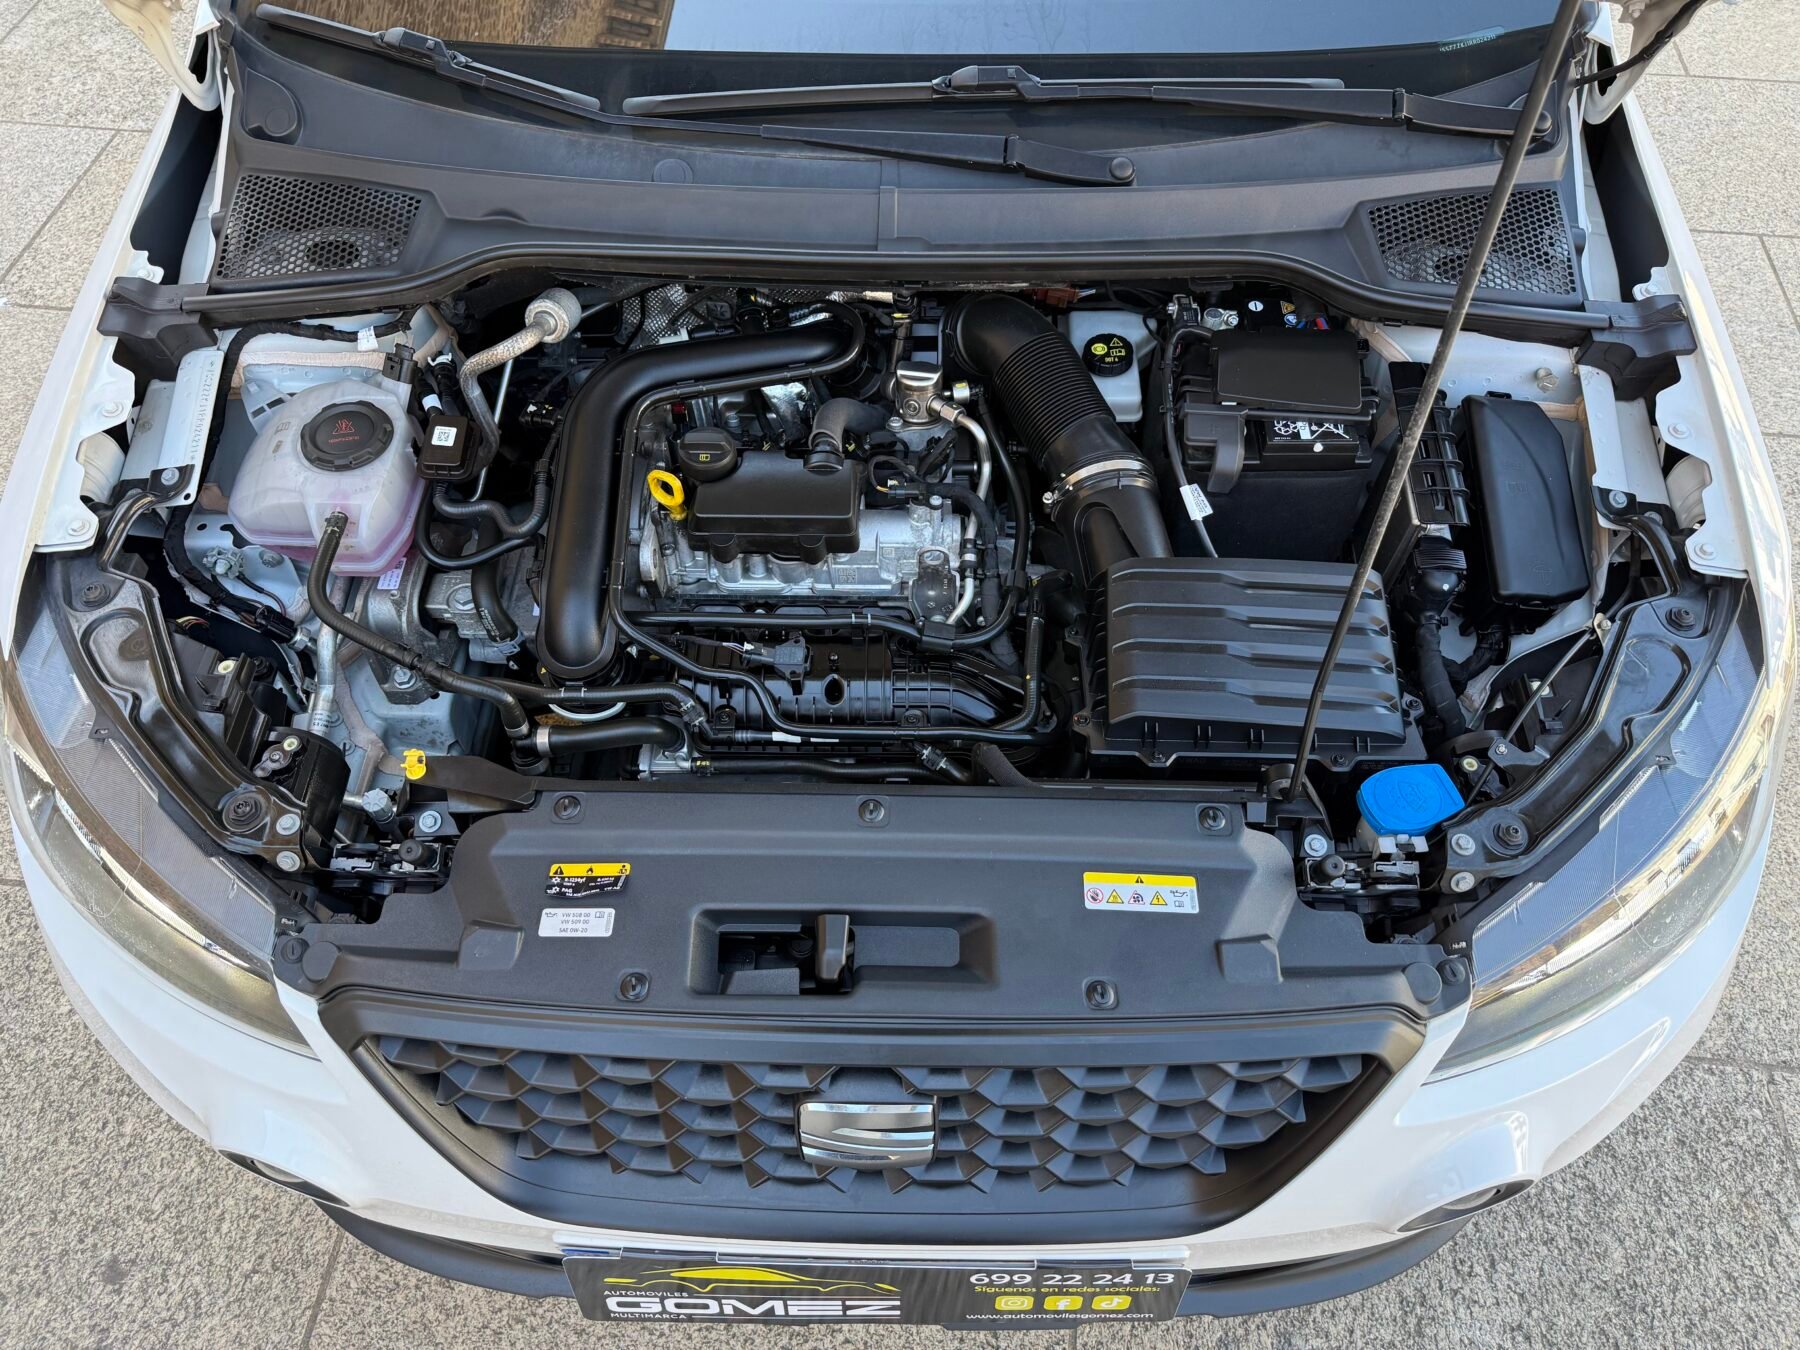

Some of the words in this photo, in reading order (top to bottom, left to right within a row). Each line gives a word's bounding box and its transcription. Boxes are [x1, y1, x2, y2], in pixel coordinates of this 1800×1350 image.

[969, 1273, 1032, 1285] 699
[1042, 1274, 1082, 1285] 22
[1093, 1274, 1133, 1285] 24
[1144, 1273, 1175, 1285] 13
[974, 1285, 1037, 1293] Síguenos
[605, 1297, 901, 1316] GOMEZ
[965, 1312, 1154, 1320] www.automovilesgomez.com
